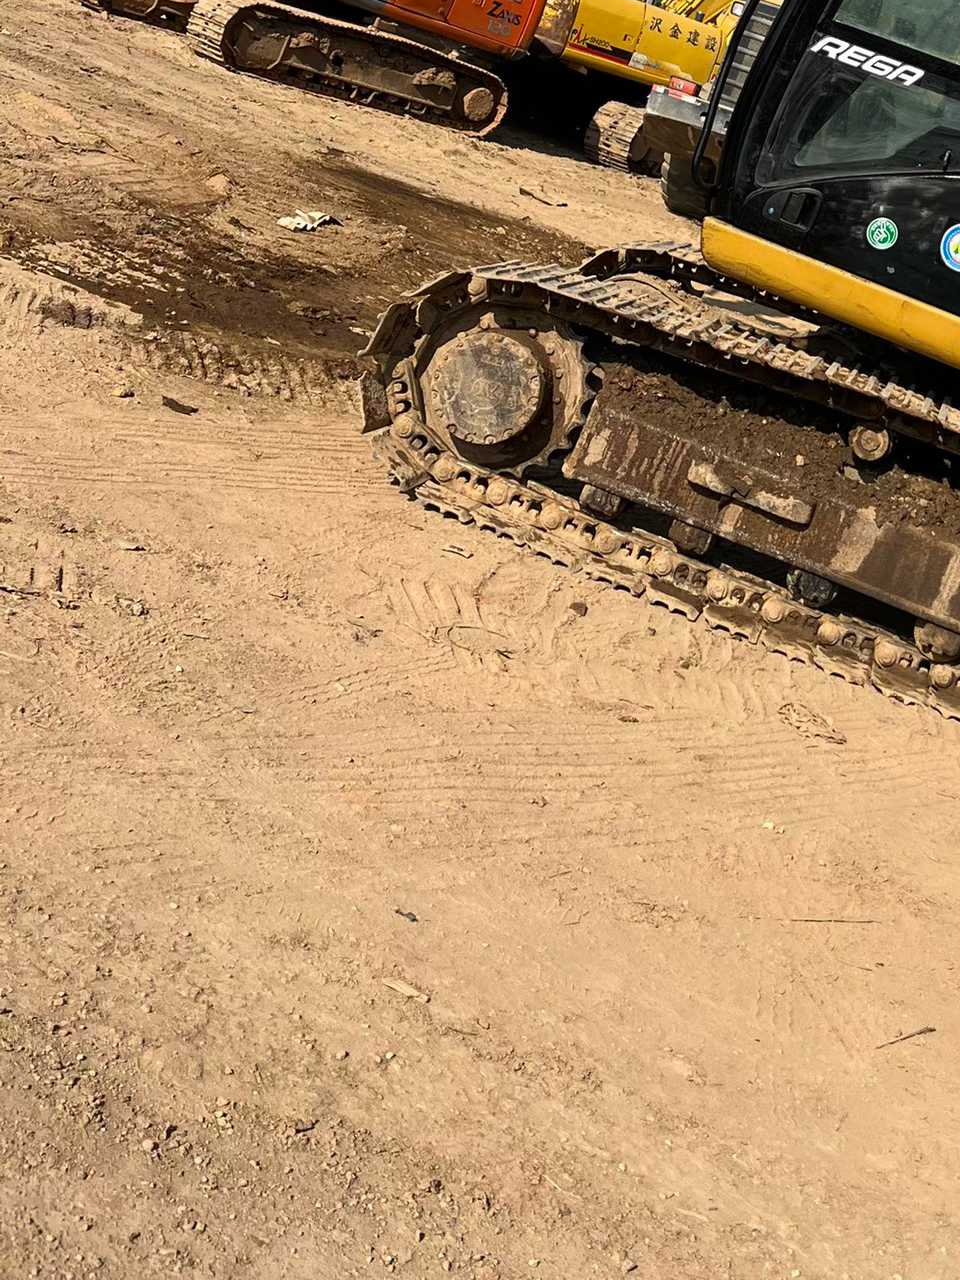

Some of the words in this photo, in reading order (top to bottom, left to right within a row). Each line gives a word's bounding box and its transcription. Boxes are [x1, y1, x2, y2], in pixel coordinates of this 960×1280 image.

[649, 16, 718, 52] 沢金建設
[810, 35, 925, 87] REGA
